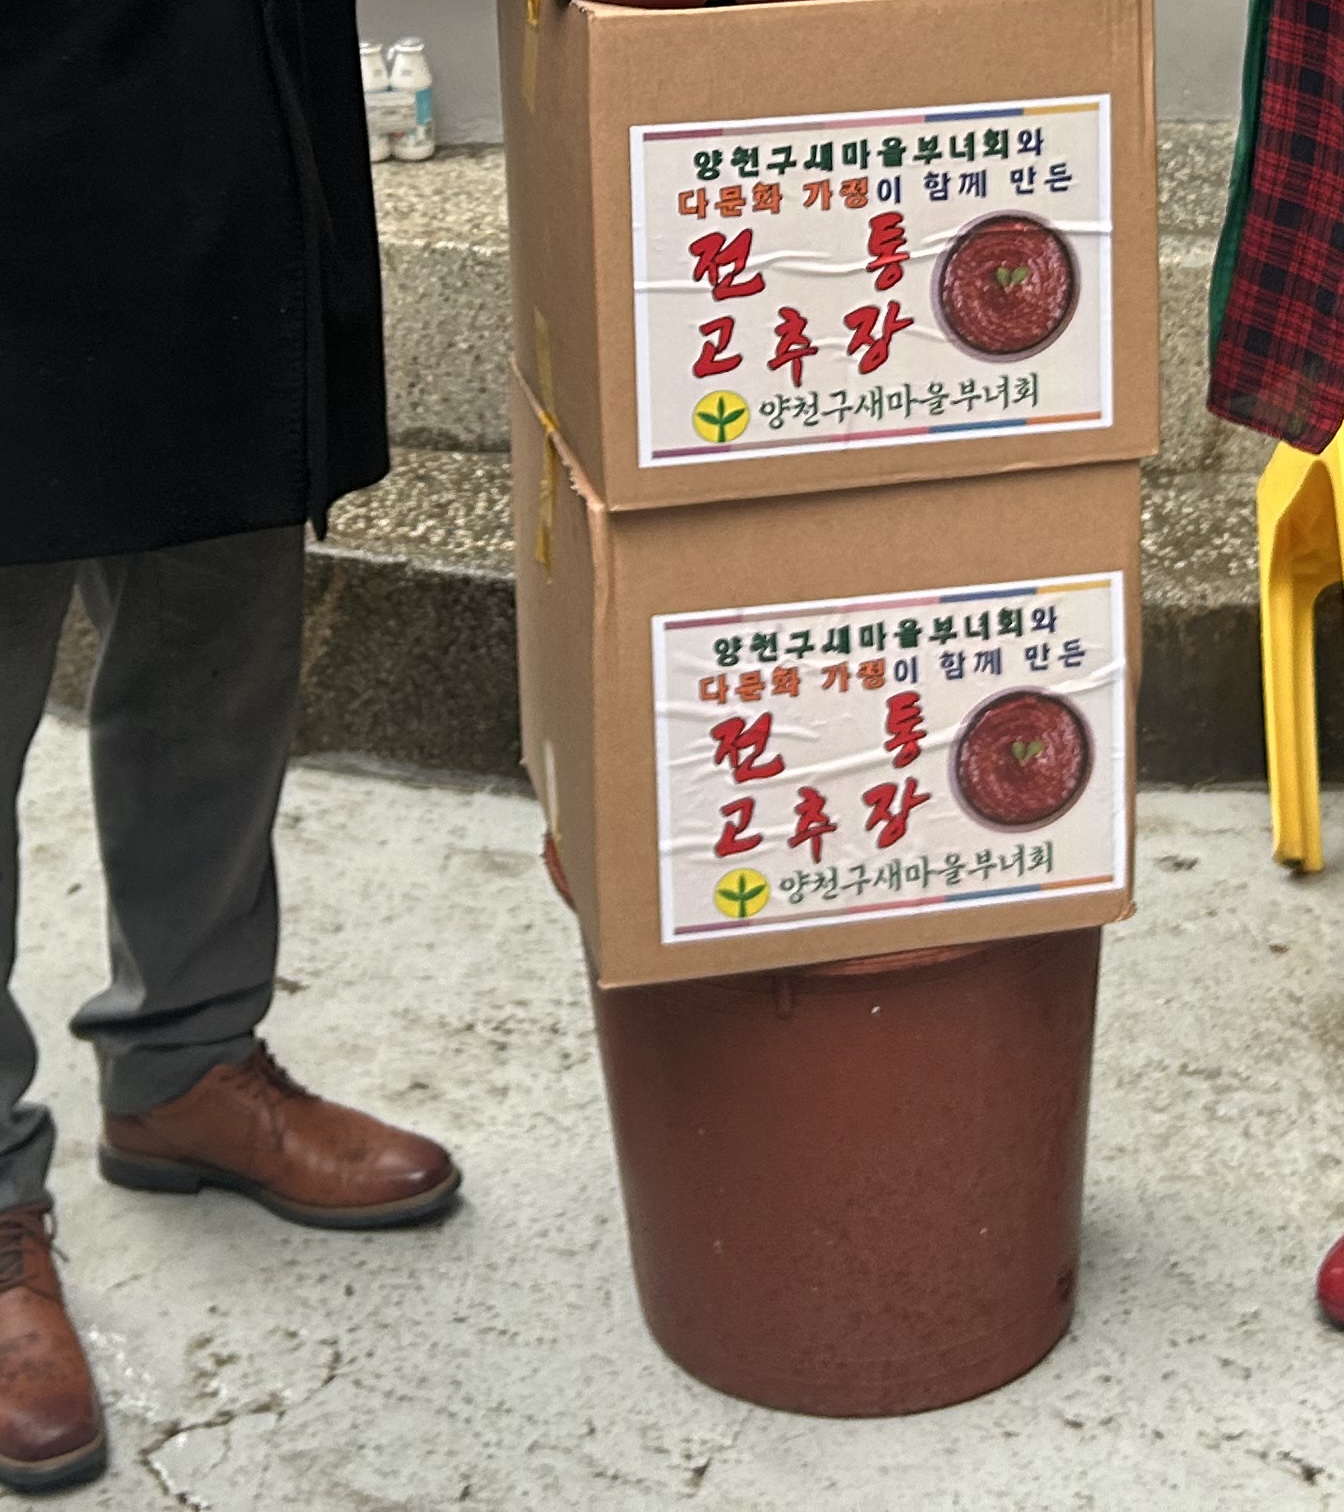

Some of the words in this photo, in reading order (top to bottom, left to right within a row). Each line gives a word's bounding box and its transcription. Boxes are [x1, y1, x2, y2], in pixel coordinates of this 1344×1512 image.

[693, 128, 1044, 181] 양천구새마을부녀회와
[677, 182, 783, 219] 다문화
[802, 176, 902, 211] 가정이
[923, 169, 988, 203] 함께
[1009, 162, 1073, 195] 만든
[759, 372, 1040, 430] 양천구새마을부녀회
[713, 606, 1059, 667] 양천구새마을부녀회와
[699, 666, 802, 705] 다문화
[821, 658, 920, 693] 가정이
[940, 649, 1002, 682] 함께
[1024, 638, 1087, 672] 만든
[779, 842, 1055, 905] 양천구새마을부녀회
